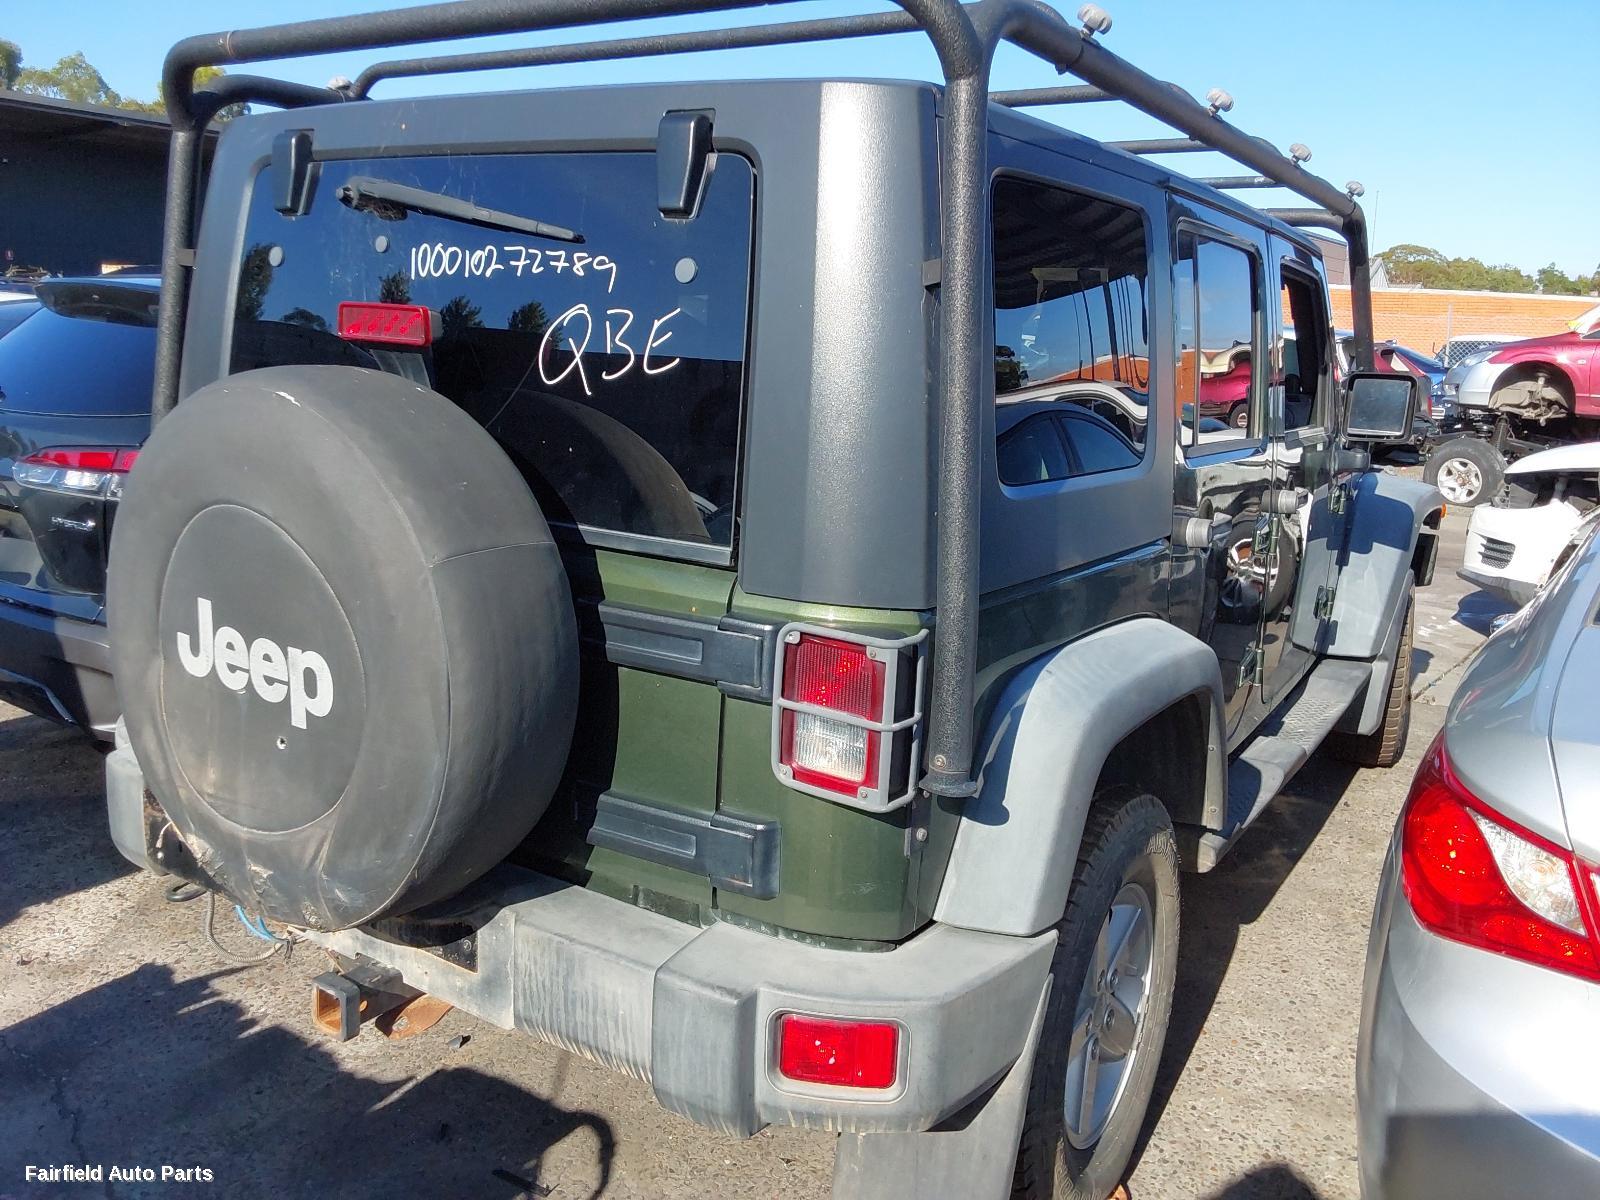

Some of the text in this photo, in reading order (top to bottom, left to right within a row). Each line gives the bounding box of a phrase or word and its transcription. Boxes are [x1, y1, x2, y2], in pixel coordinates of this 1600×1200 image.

[410, 242, 617, 293] 100010272789
[538, 303, 681, 396] QBE
[176, 597, 334, 729] Jeep
